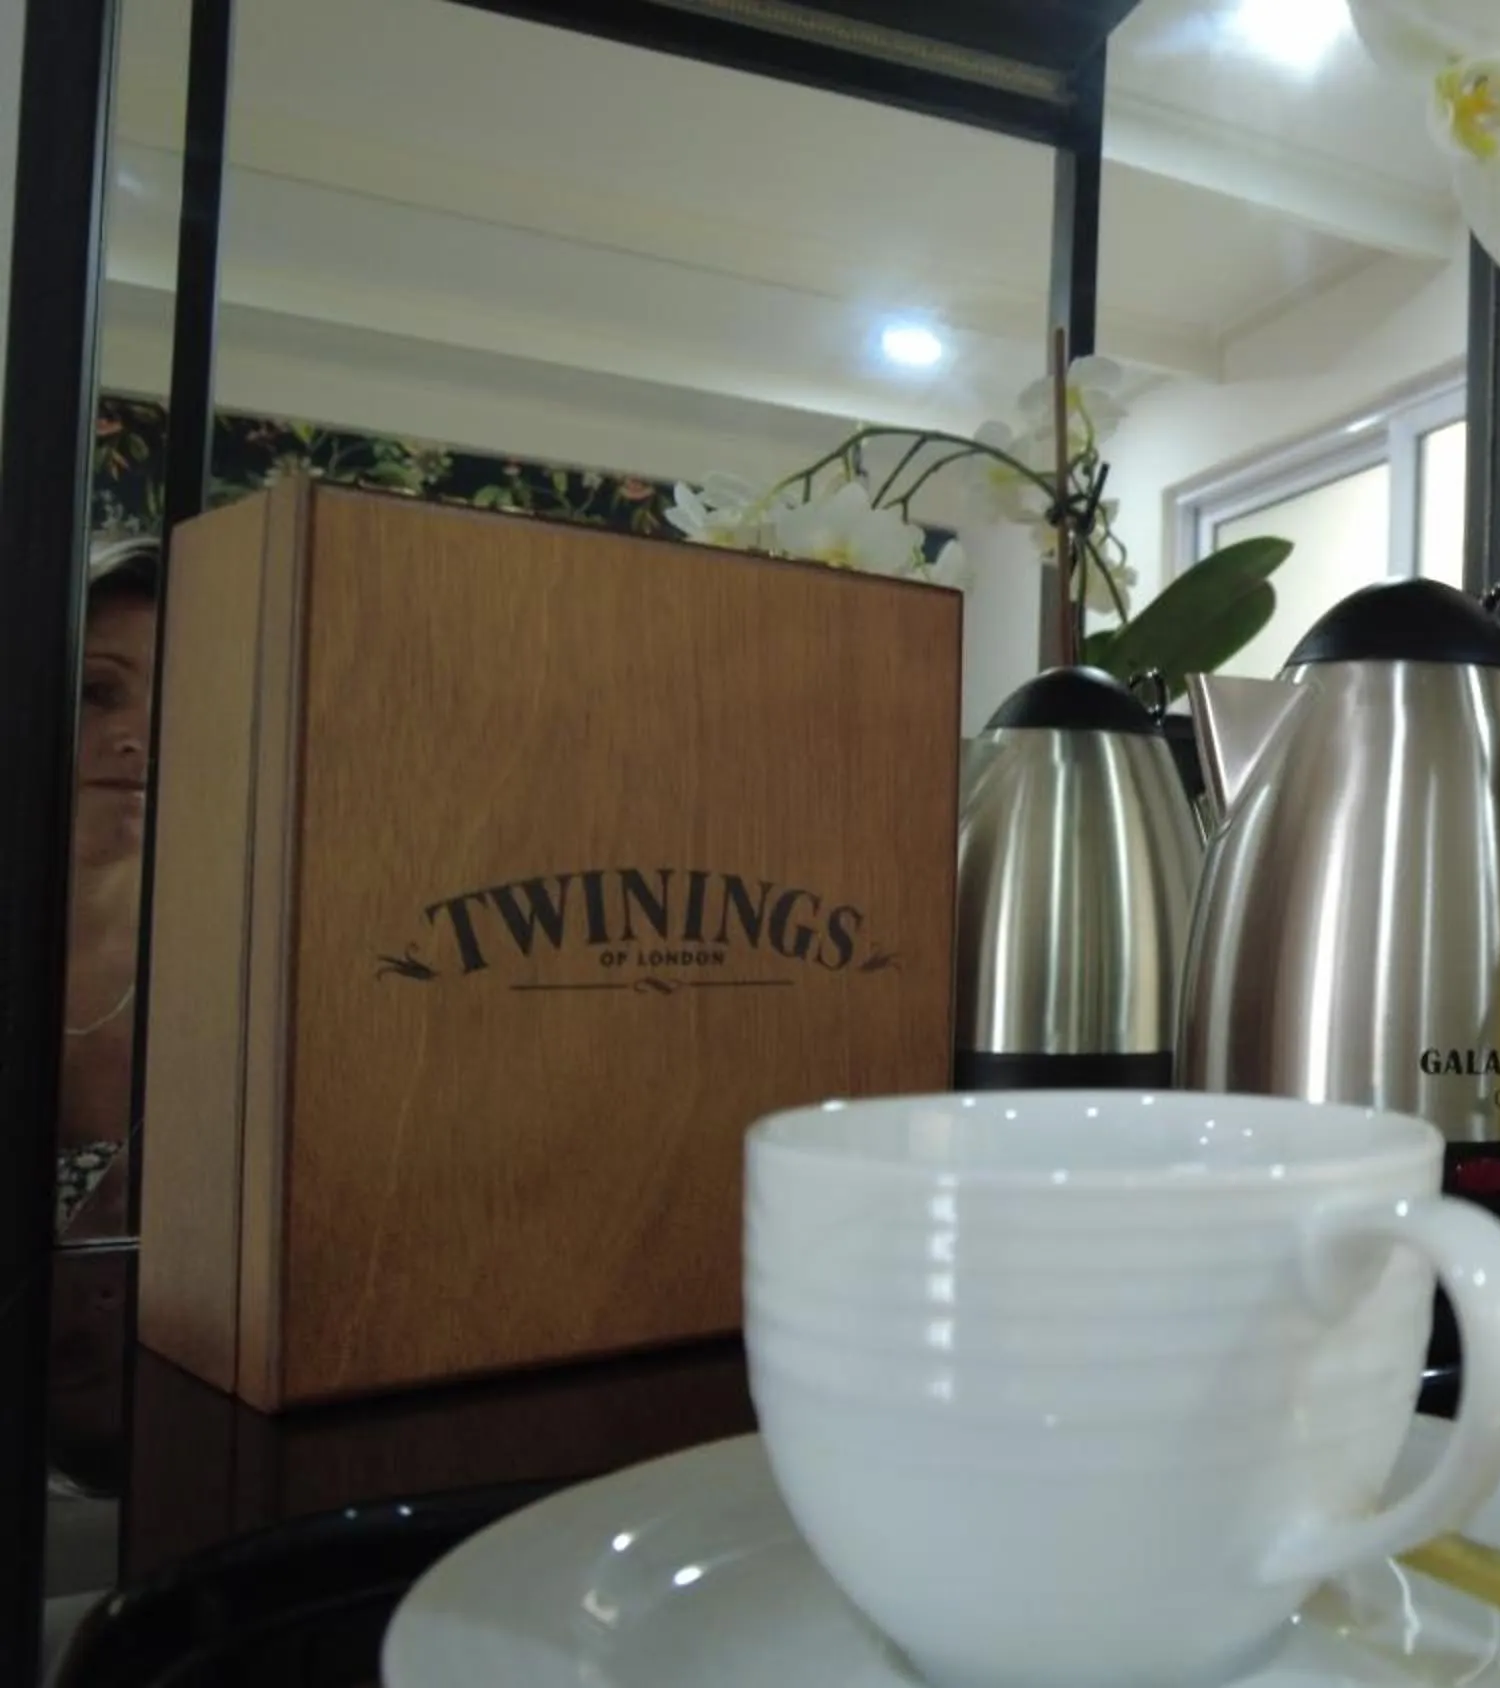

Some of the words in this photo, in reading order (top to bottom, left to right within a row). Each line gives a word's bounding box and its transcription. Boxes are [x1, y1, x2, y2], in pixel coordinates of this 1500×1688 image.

[426, 868, 863, 974] TWININGS
[600, 951, 628, 967] OF
[638, 951, 726, 967] LONDON
